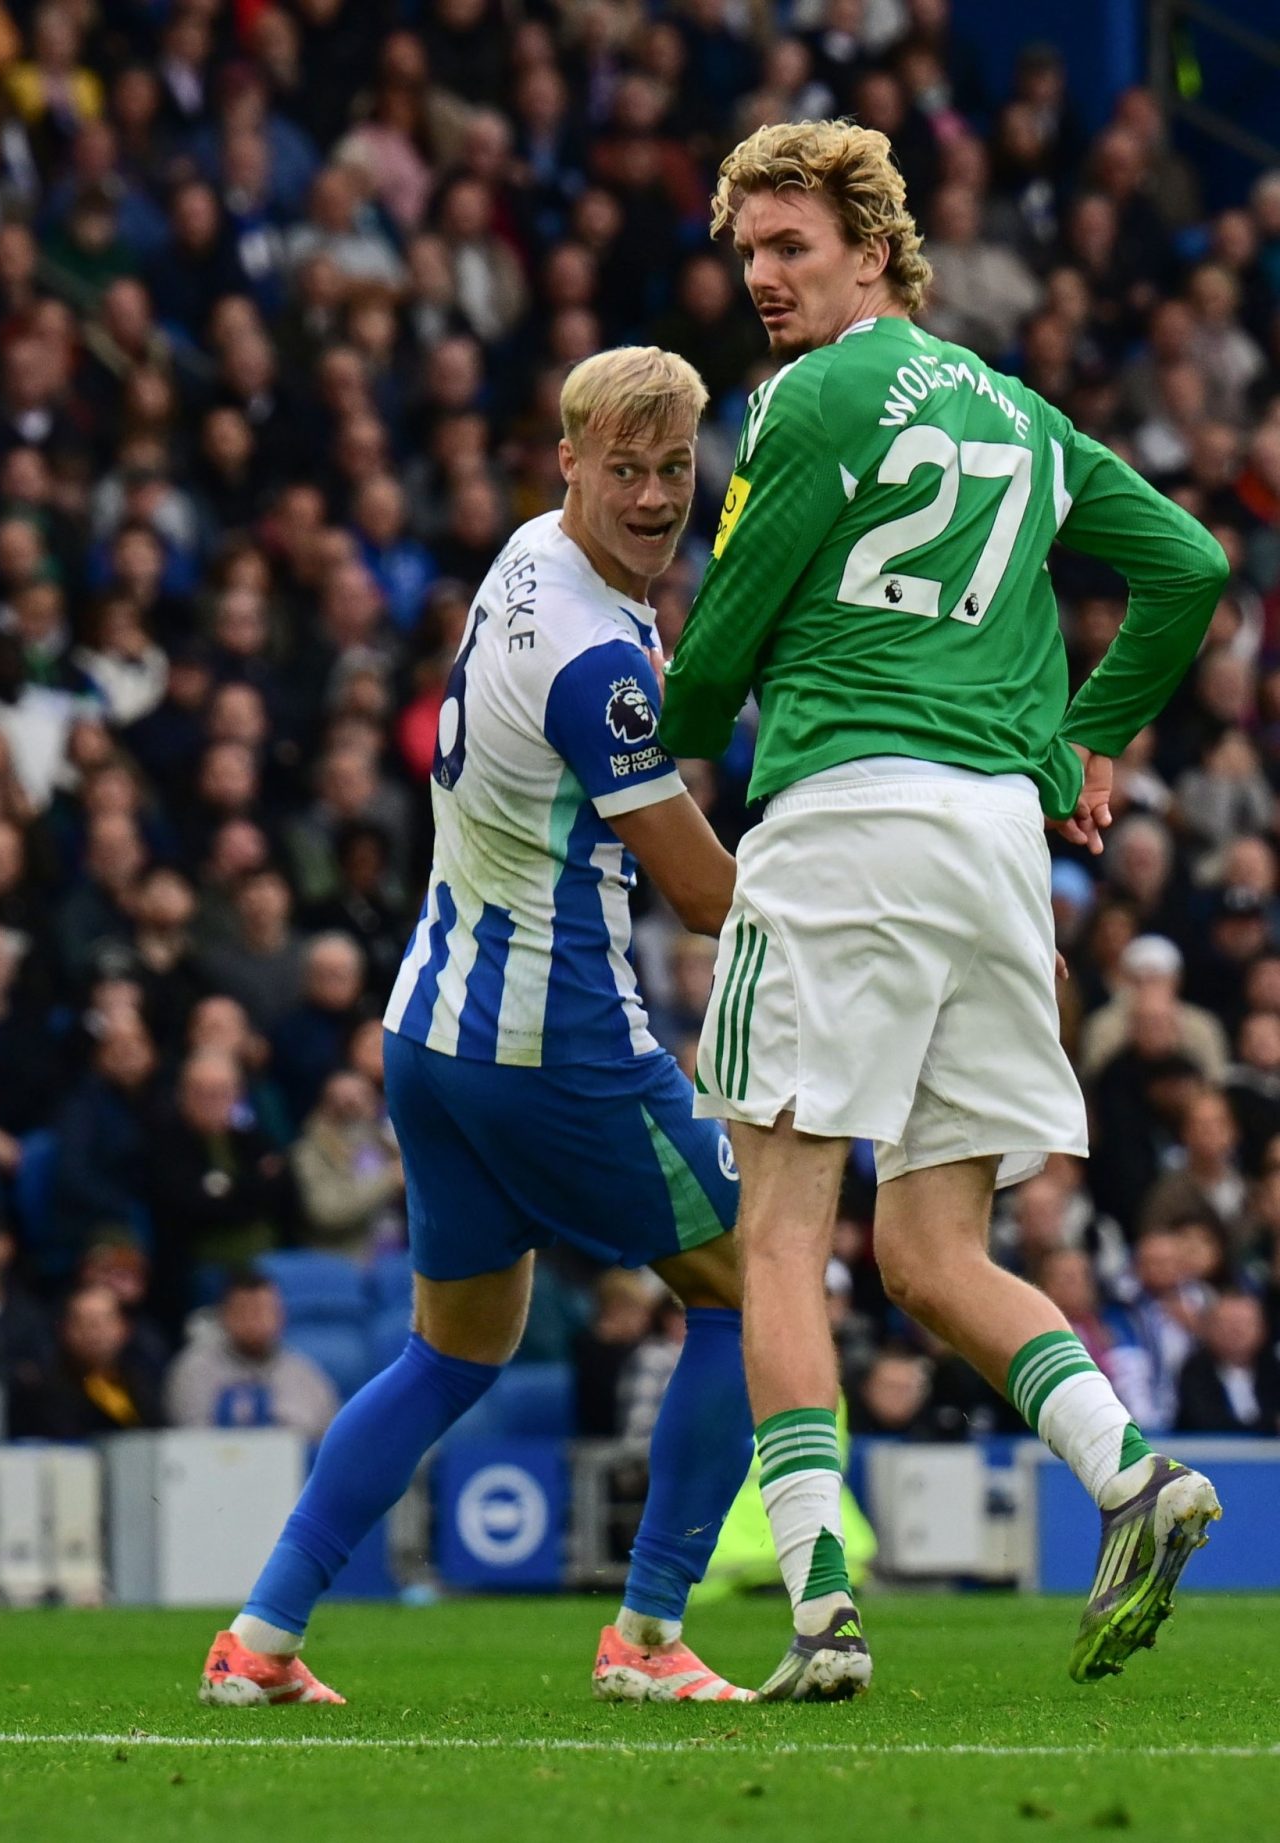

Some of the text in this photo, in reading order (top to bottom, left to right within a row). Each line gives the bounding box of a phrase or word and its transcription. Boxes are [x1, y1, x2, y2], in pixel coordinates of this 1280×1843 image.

[836, 424, 1032, 626] 27
[610, 754, 630, 767] No
[612, 764, 631, 778] for
